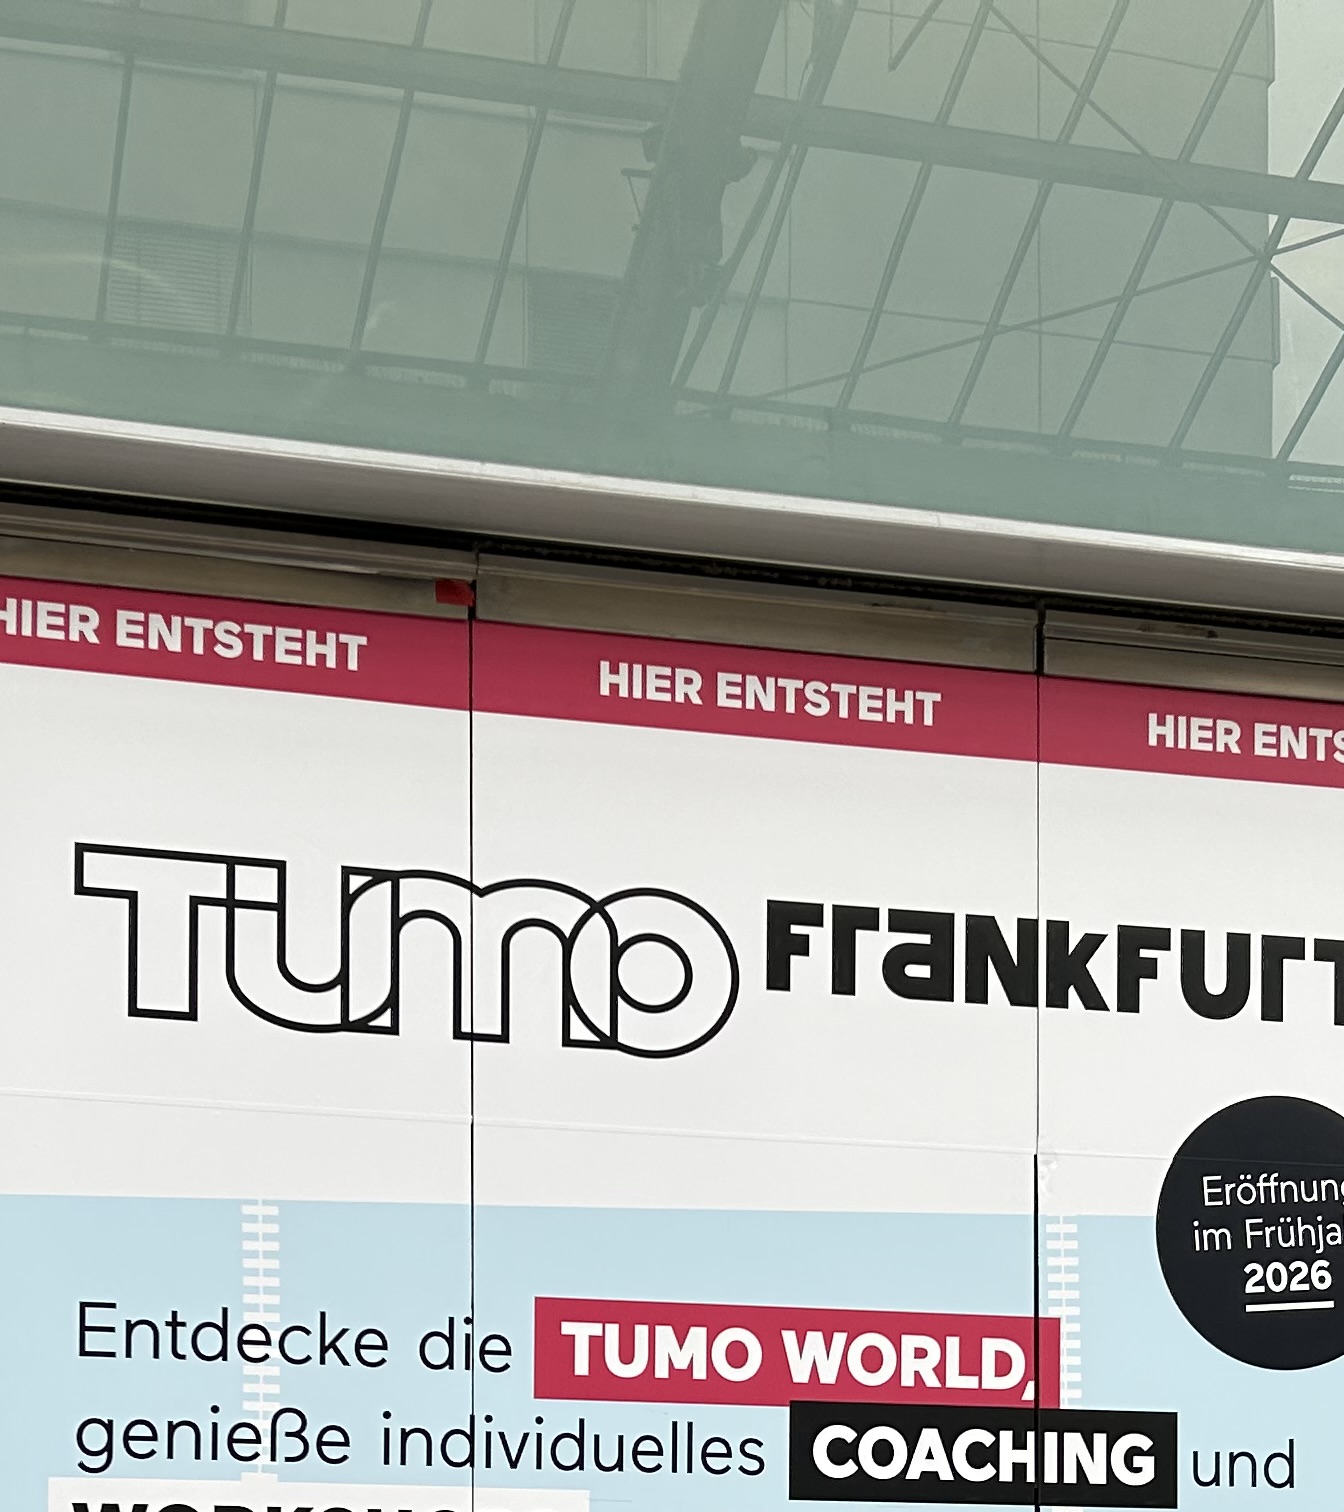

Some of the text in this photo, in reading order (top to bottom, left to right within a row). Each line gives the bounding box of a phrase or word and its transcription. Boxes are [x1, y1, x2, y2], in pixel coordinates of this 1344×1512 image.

[115, 608, 368, 672] ENTSTEHT
[599, 660, 942, 727] HIER ENTSTEHT
[1148, 712, 1242, 754] HIER
[1193, 1220, 1232, 1252] im
[1243, 1259, 1332, 1294] 2026
[78, 1301, 1035, 1401] Entdecke die TUMO WORLD,
[76, 1404, 1295, 1489] genieße individuelles COACHING und
